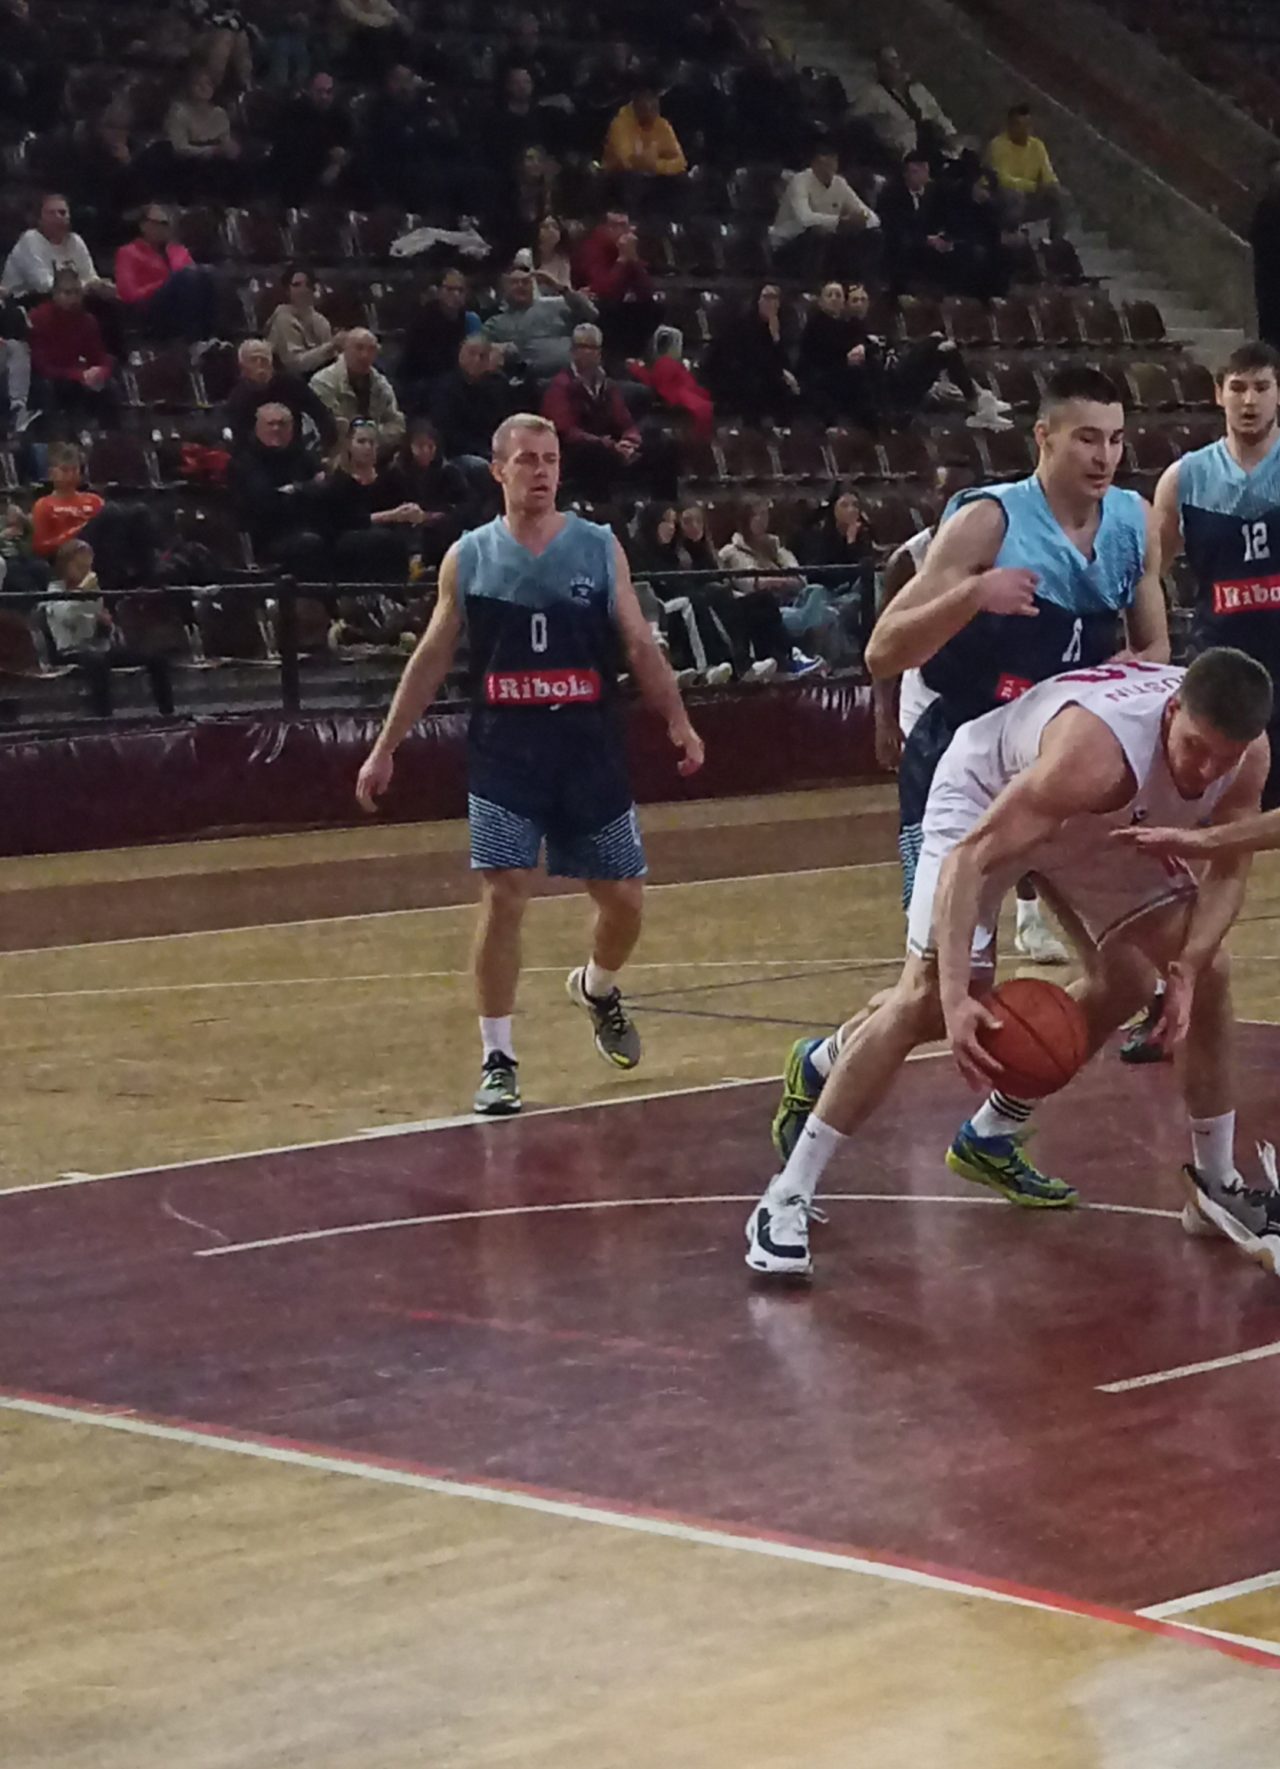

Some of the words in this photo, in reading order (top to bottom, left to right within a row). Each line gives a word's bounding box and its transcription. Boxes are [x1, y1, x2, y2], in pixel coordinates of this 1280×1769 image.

[1241, 522, 1270, 562] 12
[531, 612, 547, 653] 0
[499, 675, 594, 699] Ribola
[1105, 675, 1183, 702] USTIN
